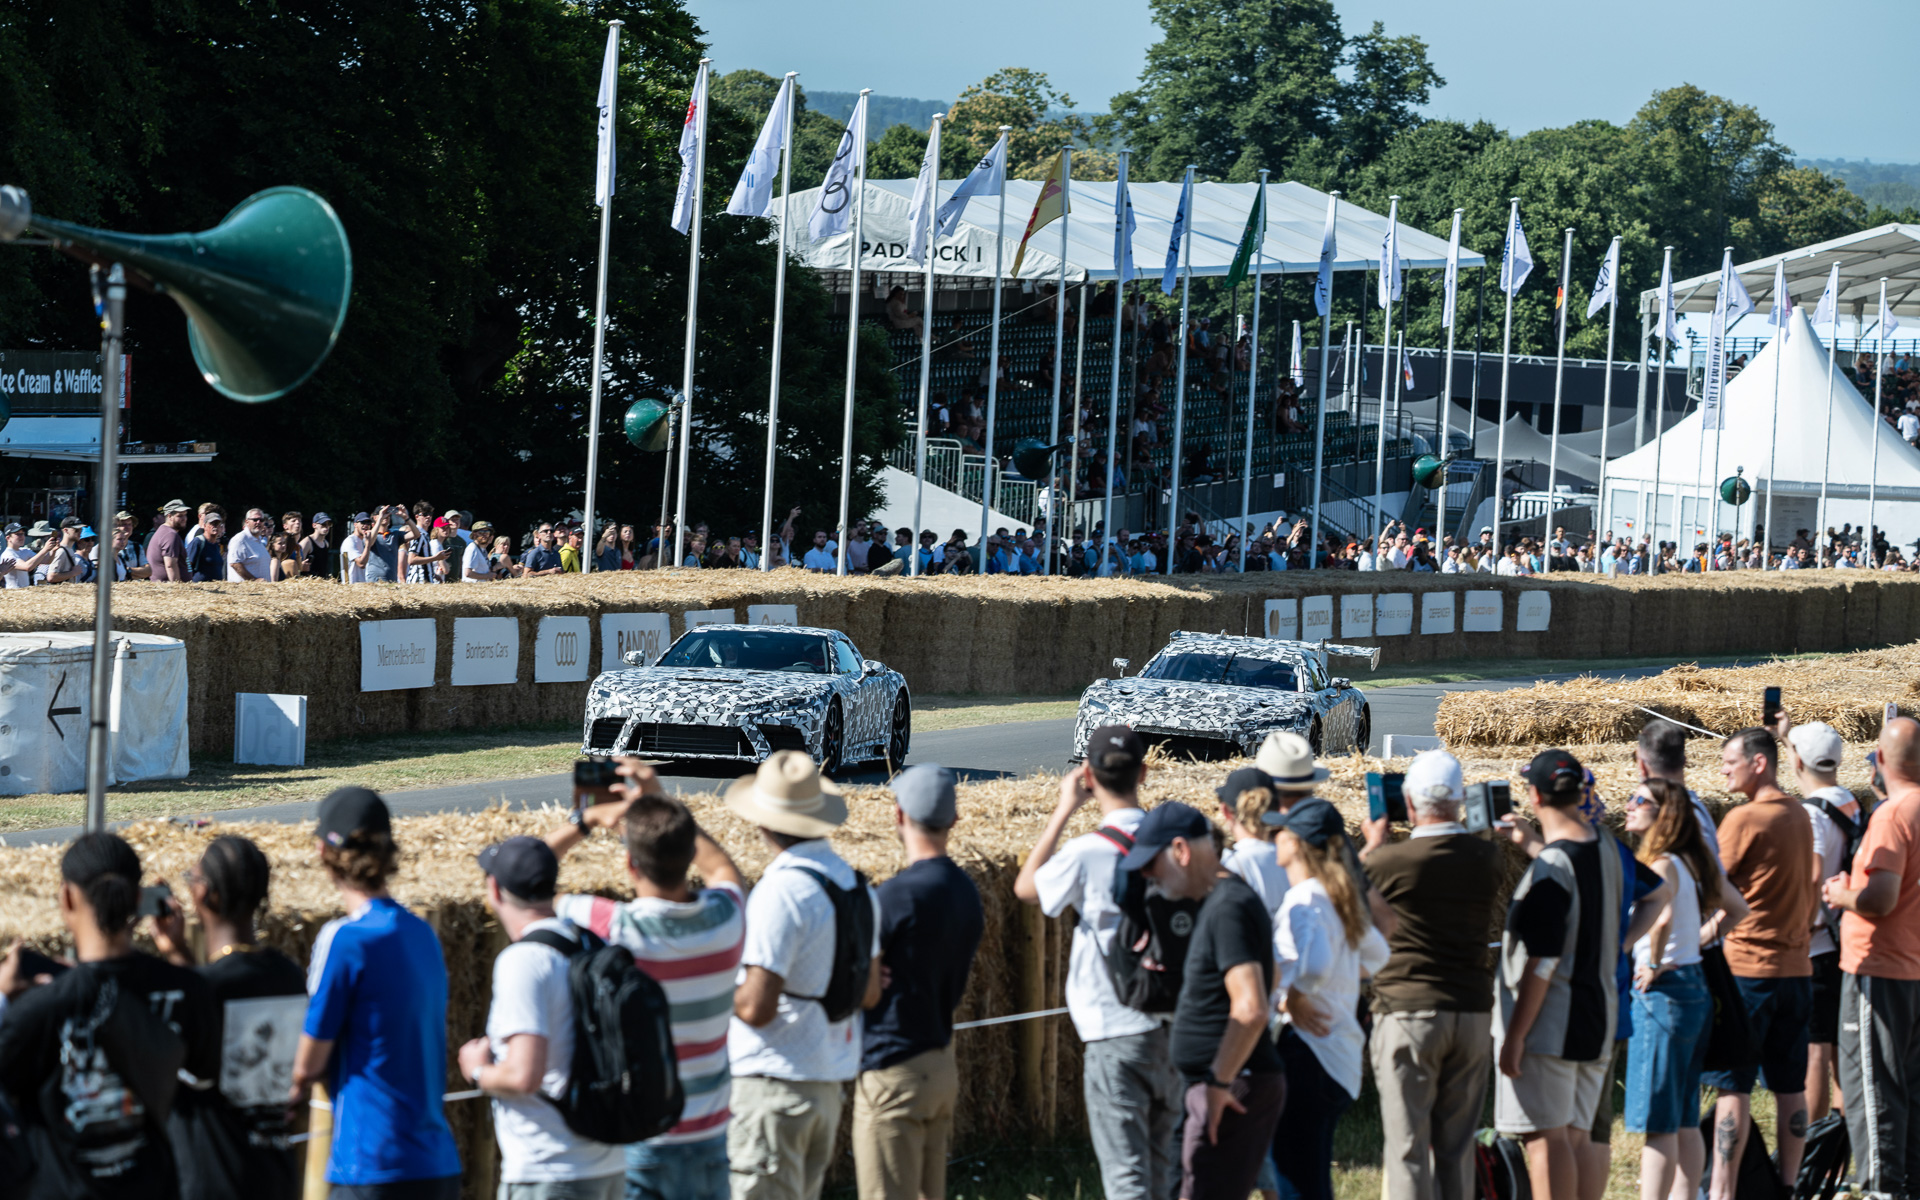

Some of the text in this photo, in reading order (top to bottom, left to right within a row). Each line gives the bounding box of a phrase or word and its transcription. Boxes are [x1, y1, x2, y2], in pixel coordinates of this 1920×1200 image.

[860, 241, 969, 263] PADOCK
[18, 368, 51, 394] Cream
[54, 369, 62, 394] &
[63, 368, 102, 394] Waffles
[1307, 610, 1329, 626] HONDA
[377, 642, 426, 667] Mercedes-Benz
[495, 642, 509, 658] Cars
[618, 629, 661, 660] RANDOX
